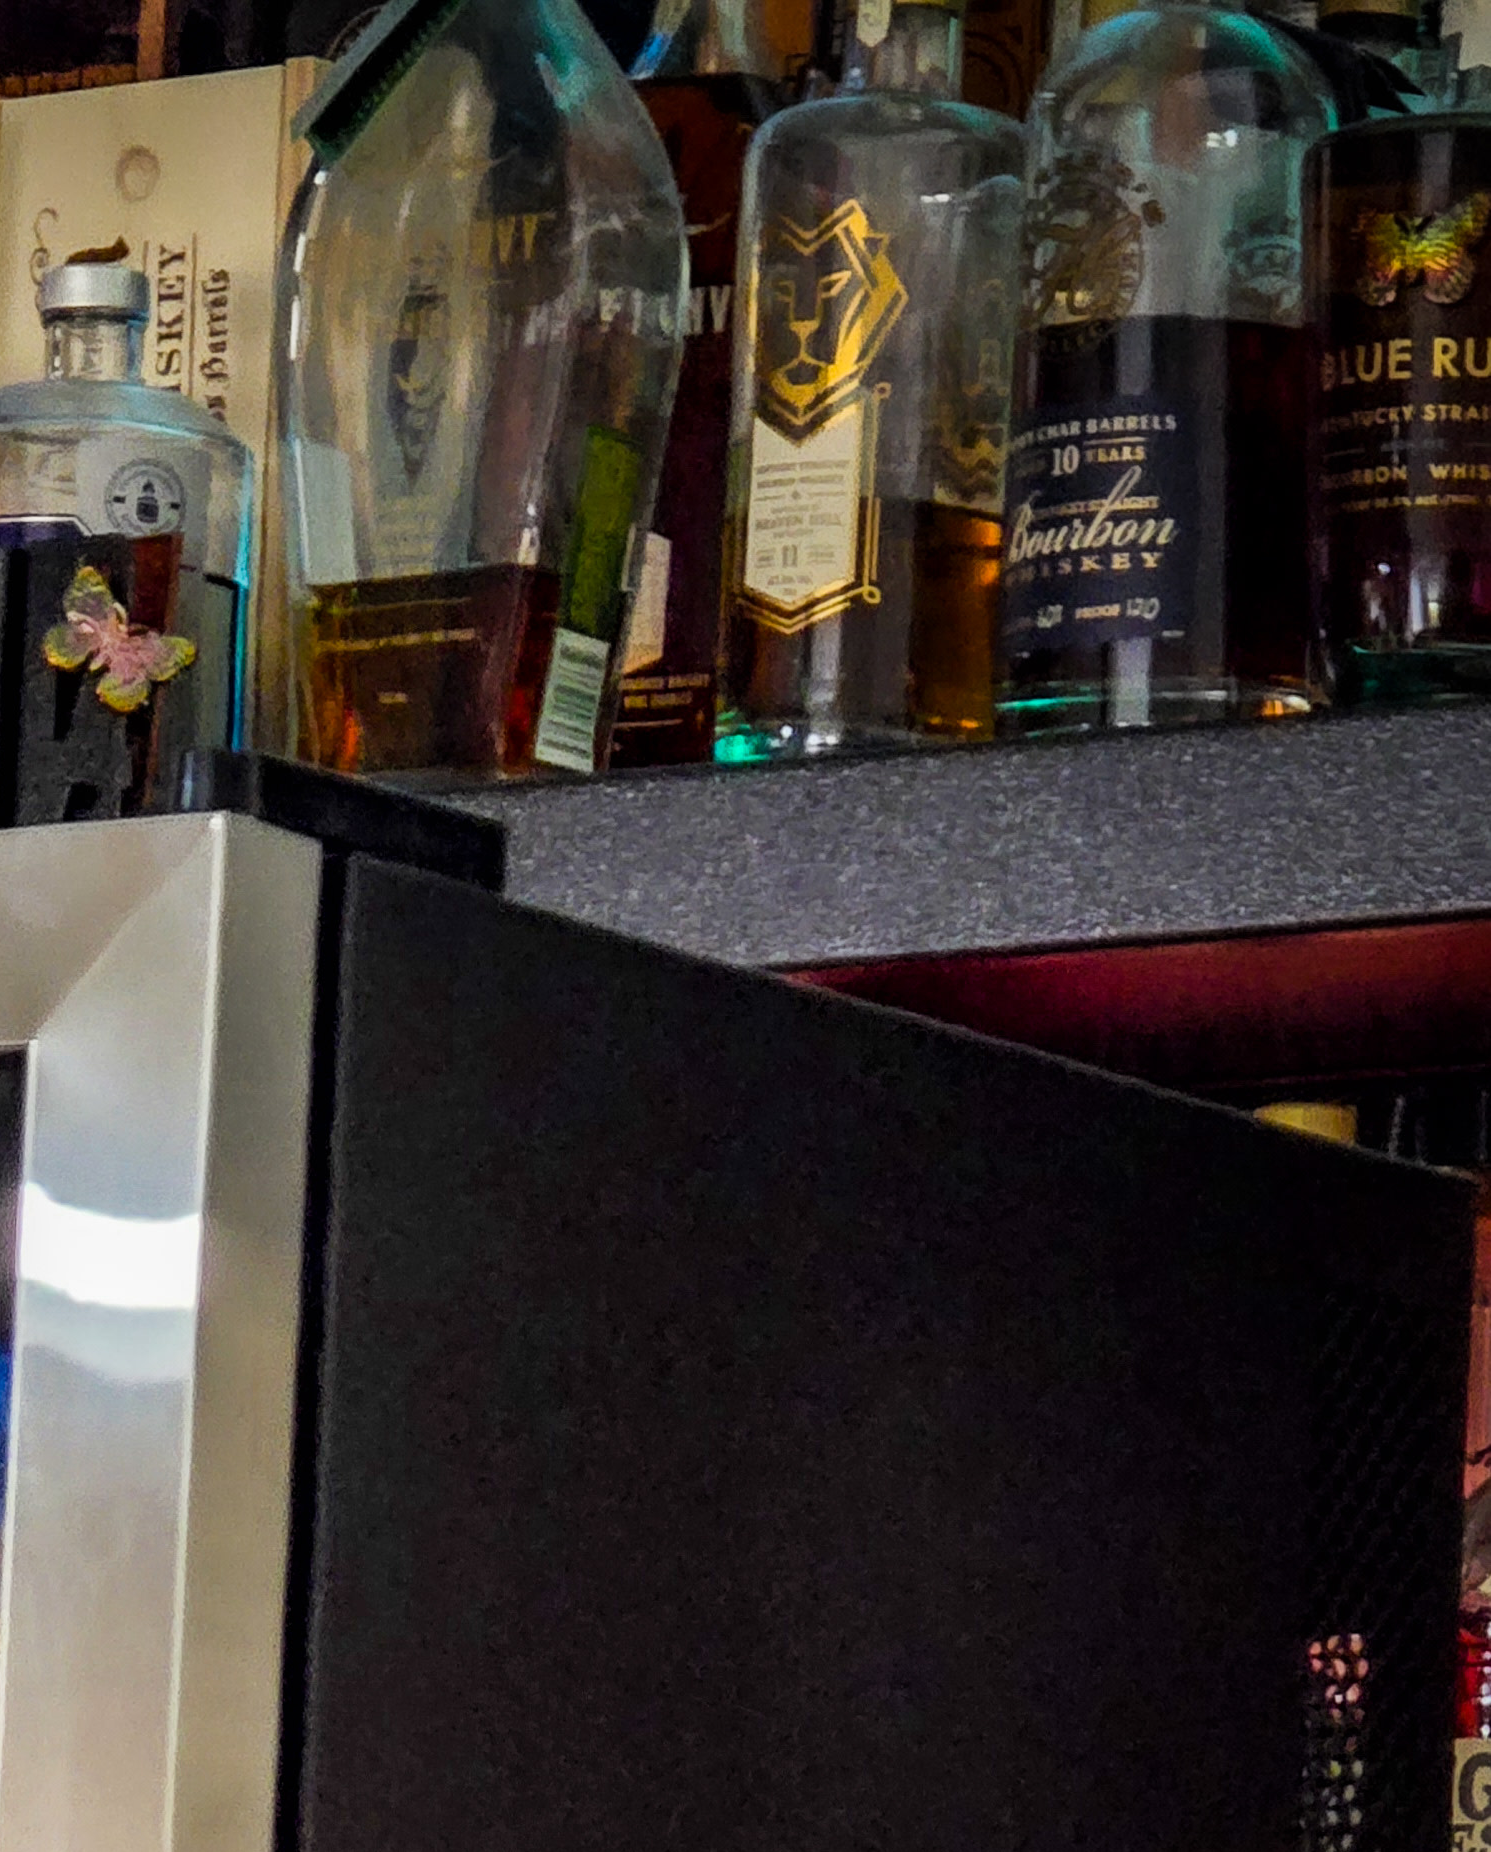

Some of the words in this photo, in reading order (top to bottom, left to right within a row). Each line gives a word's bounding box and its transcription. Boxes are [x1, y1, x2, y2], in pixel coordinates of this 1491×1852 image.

[1320, 337, 1414, 392] BLUE
[1085, 413, 1178, 434] BARRELS
[1051, 444, 1081, 477] 10
[1009, 464, 1181, 564] Bourbon
